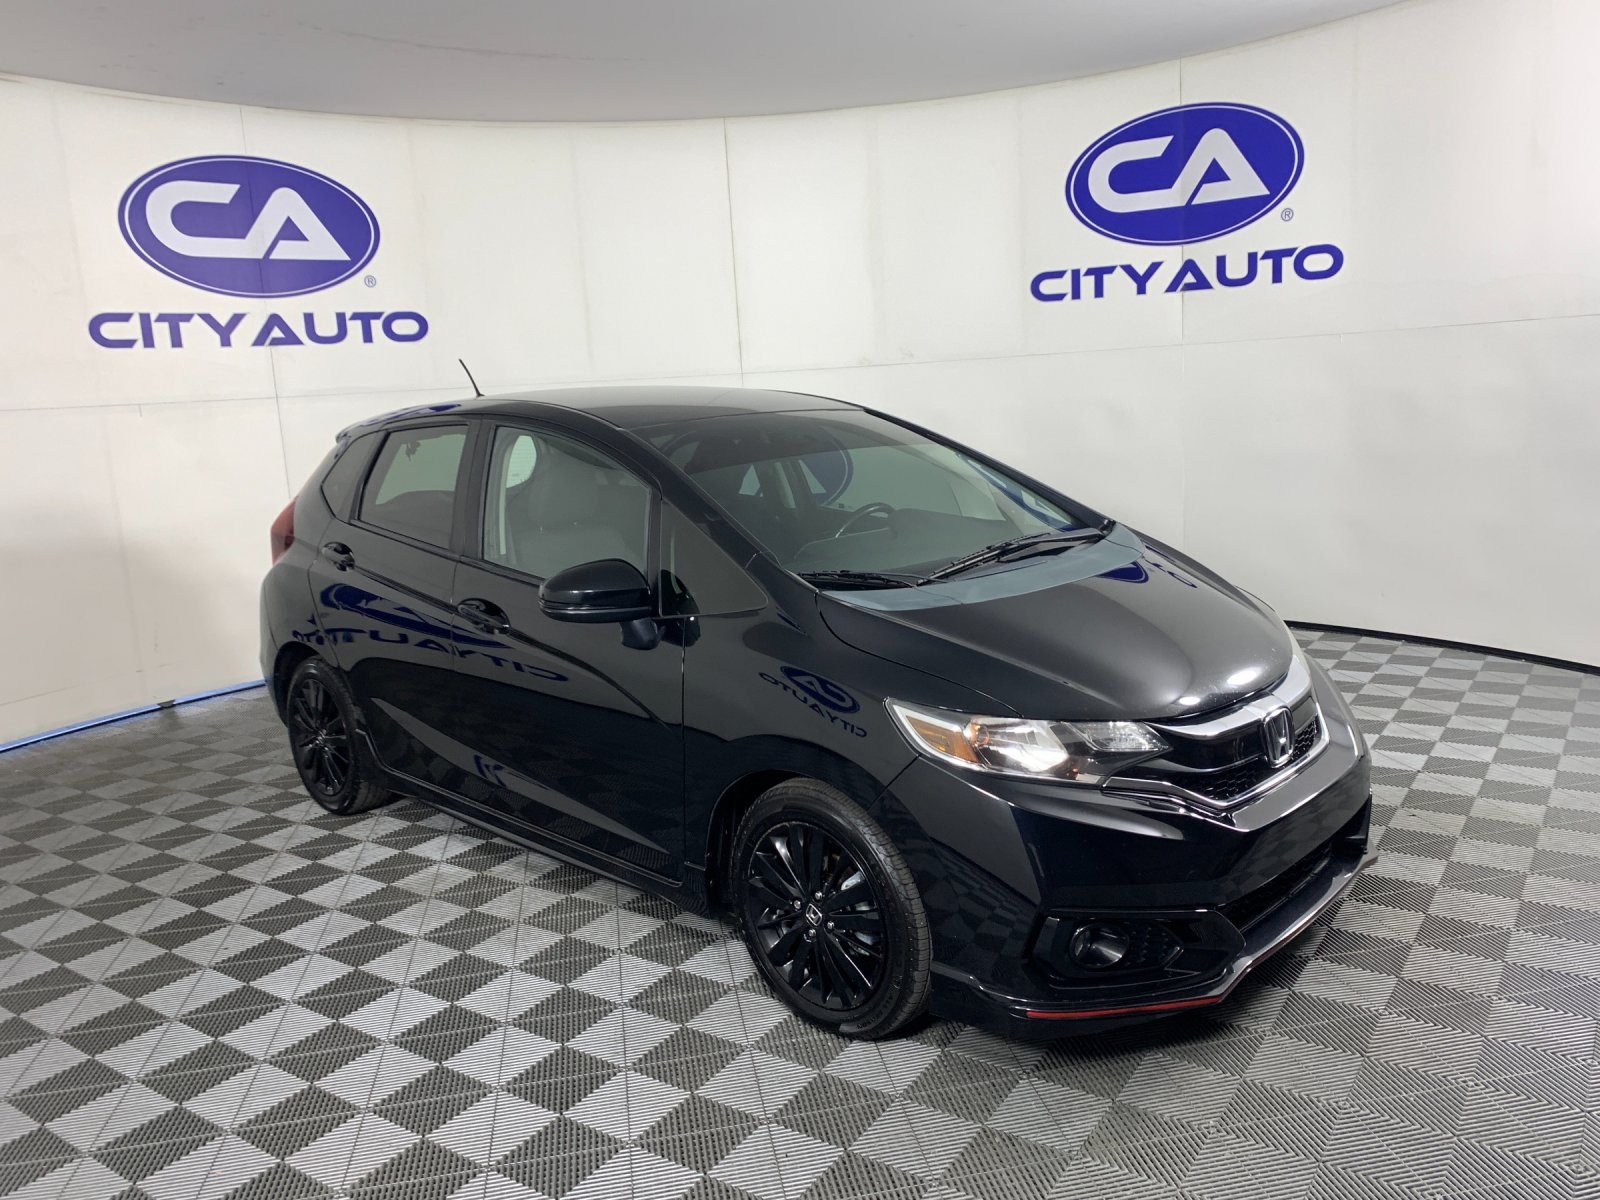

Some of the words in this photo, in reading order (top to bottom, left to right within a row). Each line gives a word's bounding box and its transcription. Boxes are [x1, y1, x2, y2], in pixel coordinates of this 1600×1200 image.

[1088, 127, 1270, 213] CA
[146, 180, 351, 260] CA
[1030, 260, 1164, 302] CITY
[1165, 244, 1344, 293] AUTO
[88, 312, 249, 348] CITY
[251, 311, 429, 347] AUTO
